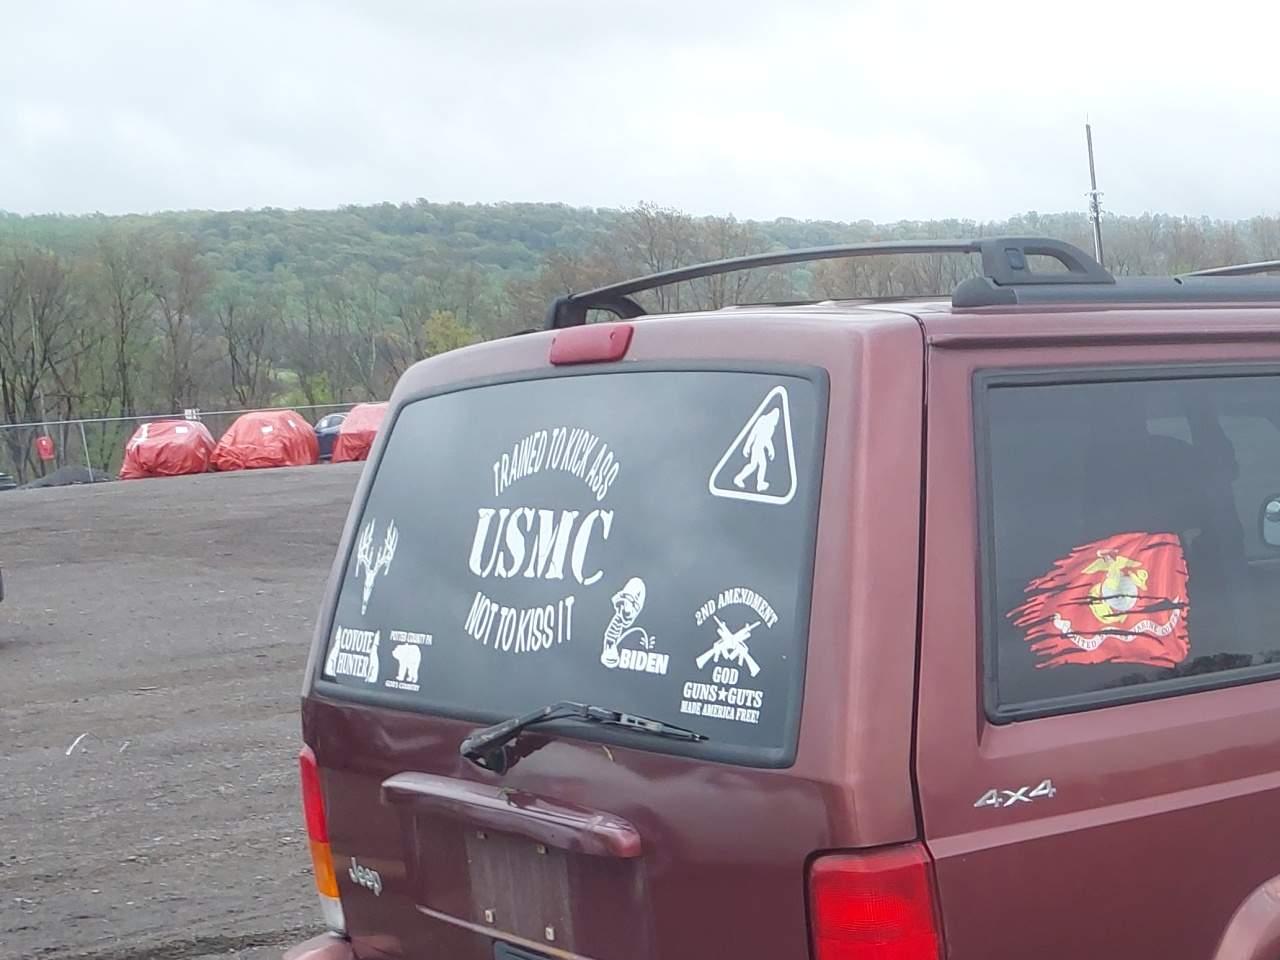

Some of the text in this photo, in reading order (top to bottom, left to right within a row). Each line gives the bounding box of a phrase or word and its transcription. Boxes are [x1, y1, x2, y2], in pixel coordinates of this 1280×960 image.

[493, 426, 620, 502] TRAINED TO KICK ASS
[468, 506, 614, 586] USMC
[464, 591, 575, 654] NOT TO KISS IT
[695, 587, 779, 629] 2ND AMENDMENT
[341, 628, 374, 653] COYOTE
[336, 652, 369, 677] HUNTER
[618, 648, 670, 675] BIDEN
[712, 666, 739, 685] GOD
[680, 700, 760, 724] MADE AMERICA FREE!
[349, 856, 383, 897] Jeep
